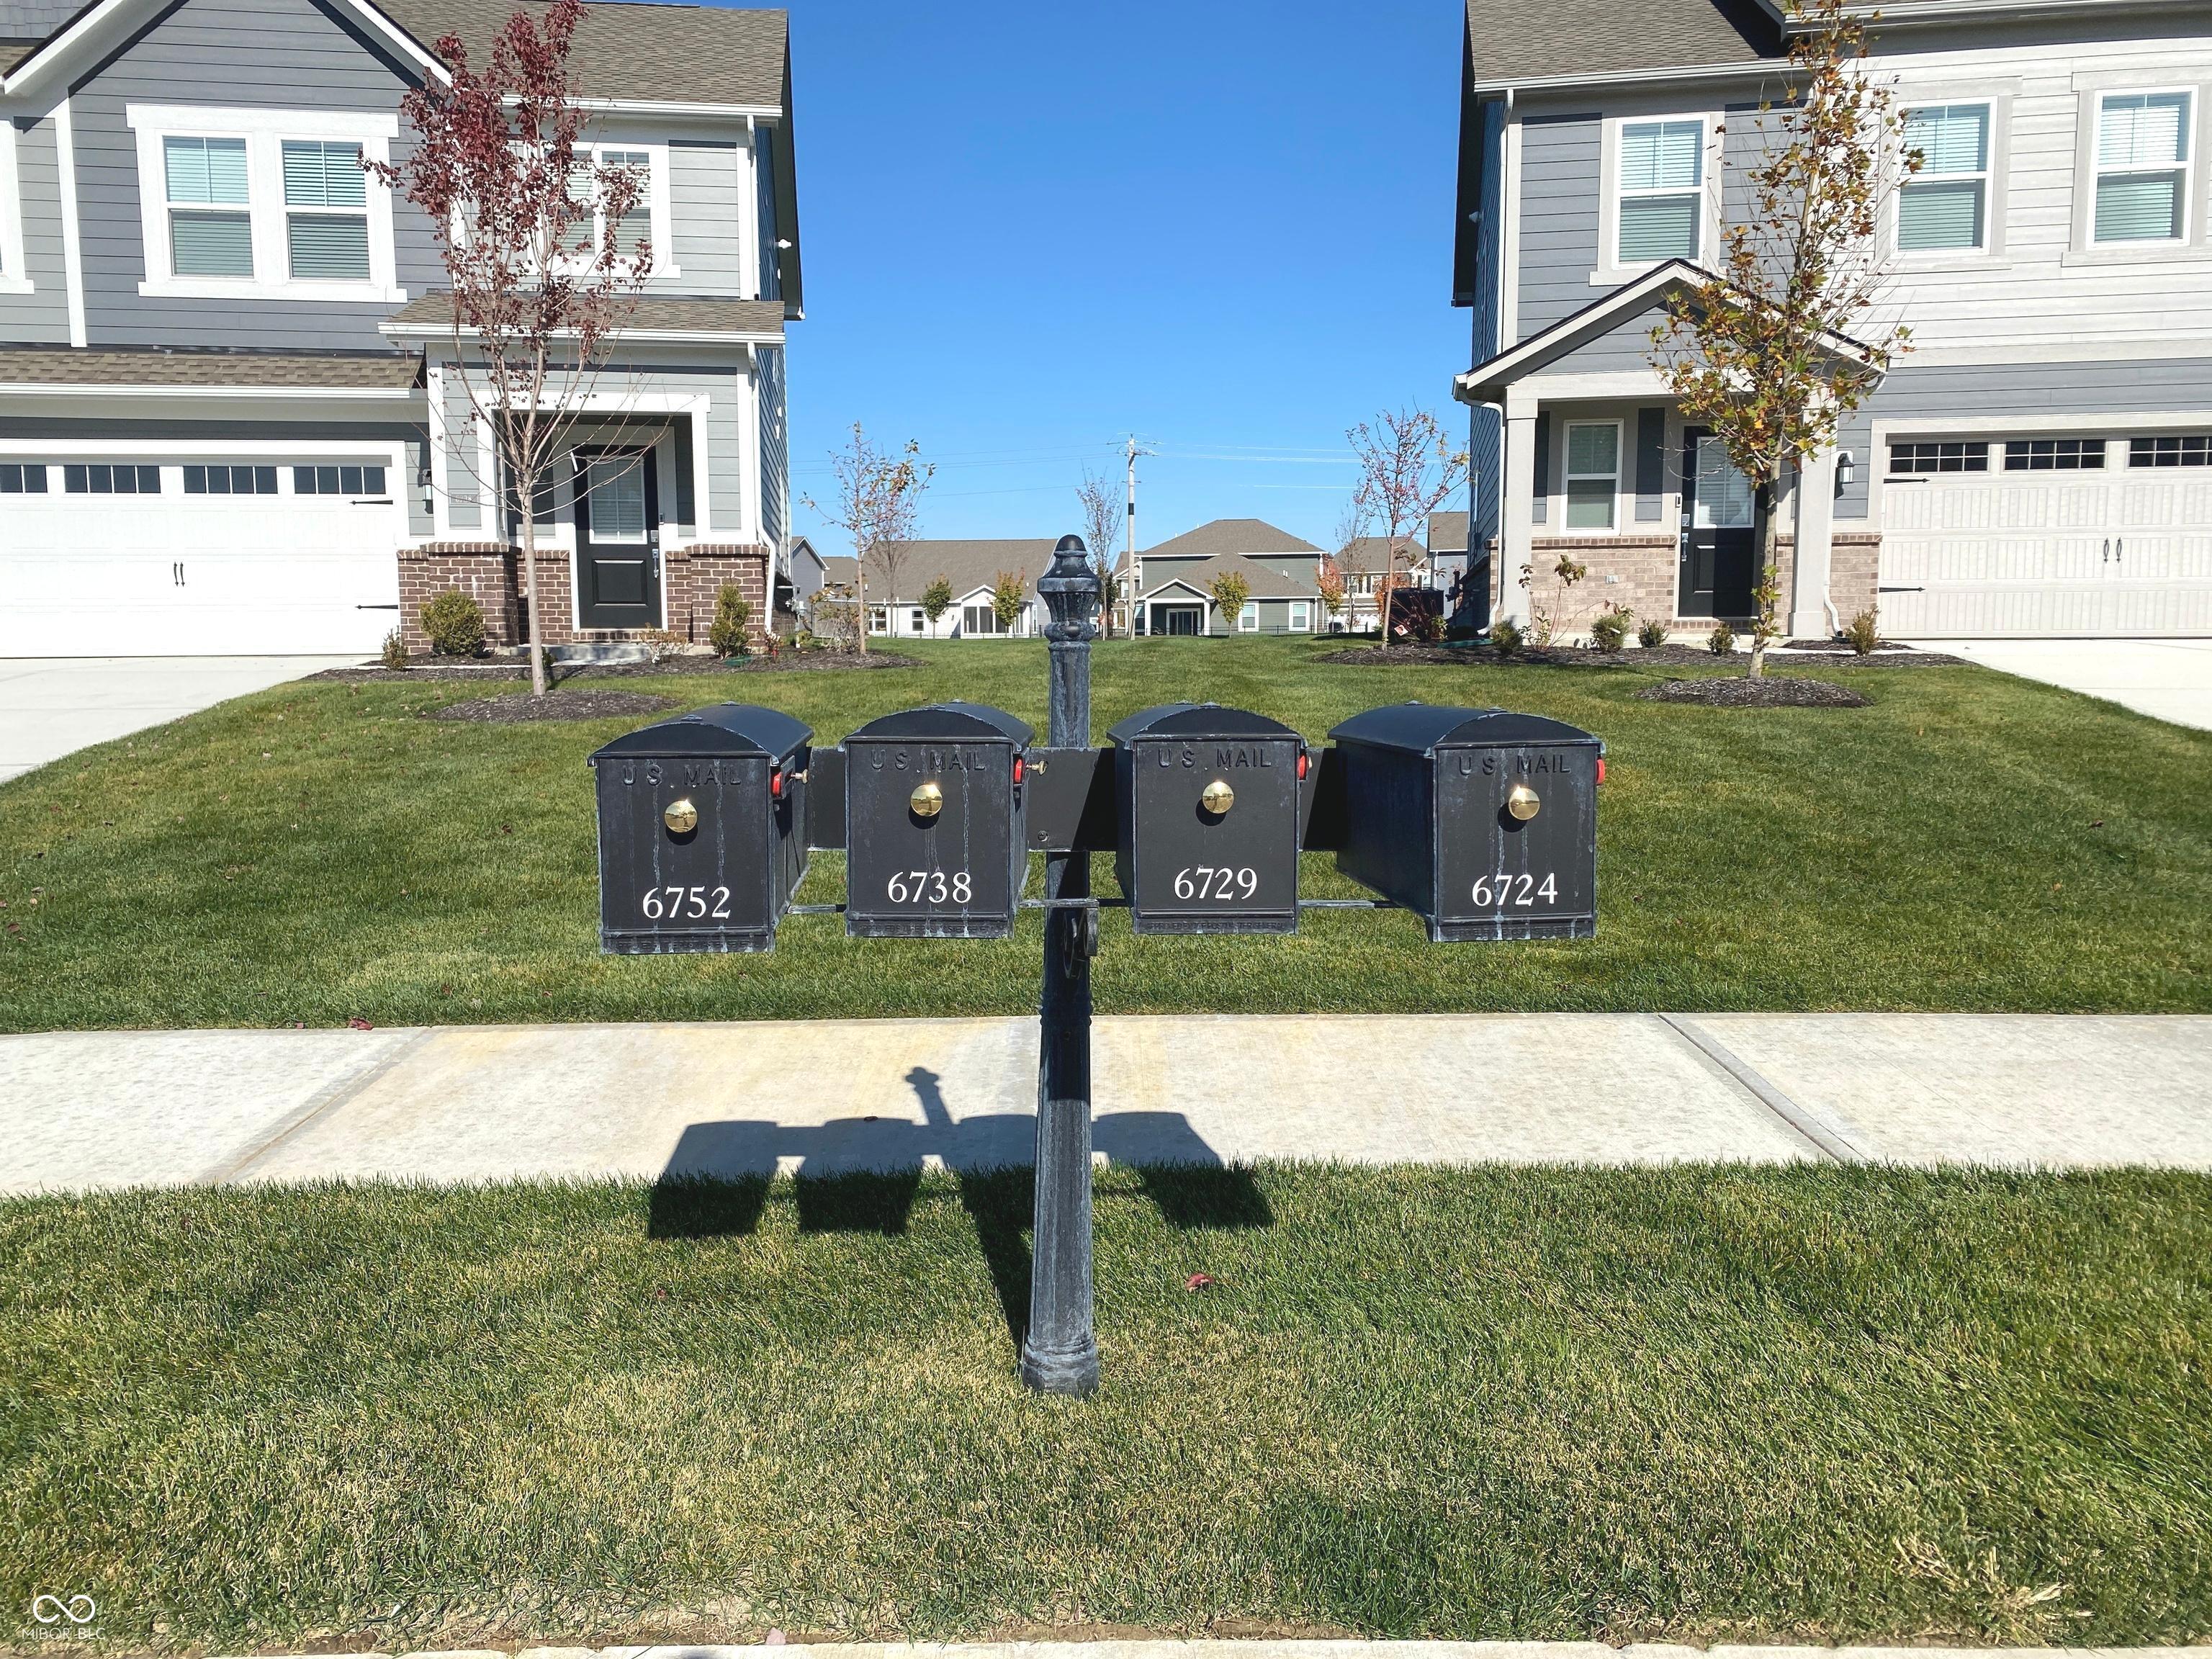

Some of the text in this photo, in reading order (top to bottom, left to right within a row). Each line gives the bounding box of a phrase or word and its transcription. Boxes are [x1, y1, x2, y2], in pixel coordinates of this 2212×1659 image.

[871, 750, 986, 770] U S MAIL
[1158, 748, 1272, 768] U S MAIL
[1459, 755, 1571, 776] U S MAIL
[623, 763, 742, 786] U S MAIL
[887, 871, 971, 904] 6738
[1174, 867, 1257, 901] 6729
[1472, 872, 1558, 907] 6724
[642, 886, 731, 920] 6752
